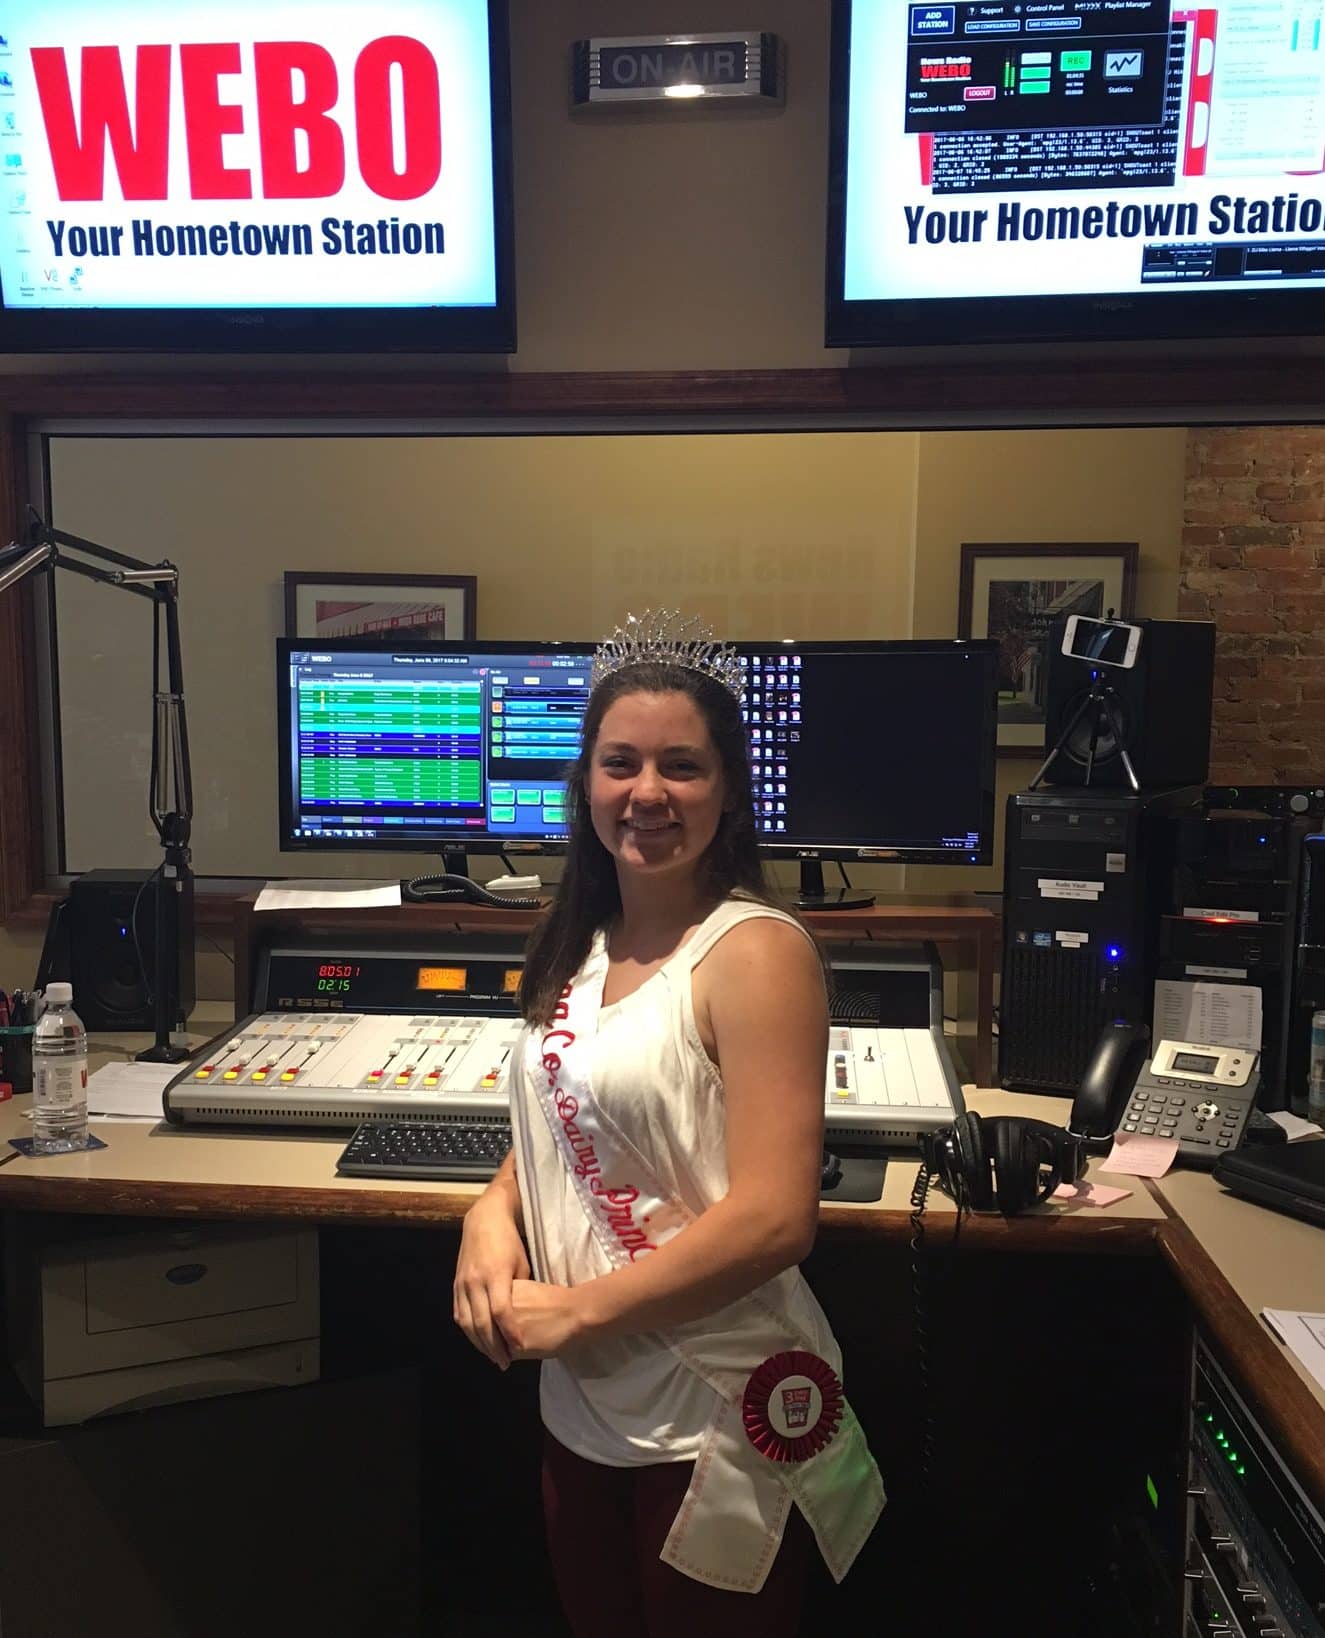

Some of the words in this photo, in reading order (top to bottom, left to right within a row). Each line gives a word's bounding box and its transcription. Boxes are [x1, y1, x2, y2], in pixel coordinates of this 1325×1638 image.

[980, 6, 1004, 15] Support
[1126, 1, 1152, 9] Manager
[918, 20, 948, 28] STATION
[612, 54, 663, 84] ON
[680, 50, 736, 80] AIR
[922, 64, 972, 78] WEBO
[1068, 56, 1084, 64] REC
[30, 35, 442, 201] WEBO
[909, 106, 938, 114] Connected
[904, 206, 988, 244] Your
[996, 202, 1200, 242] Hometown
[1208, 193, 1325, 235] Statio
[46, 220, 124, 257] Your
[132, 220, 312, 256] Hometown
[320, 217, 445, 255] Station
[542, 1030, 576, 1086] Co.
[554, 1086, 602, 1180] Dairy
[590, 1176, 658, 1263] Princ
